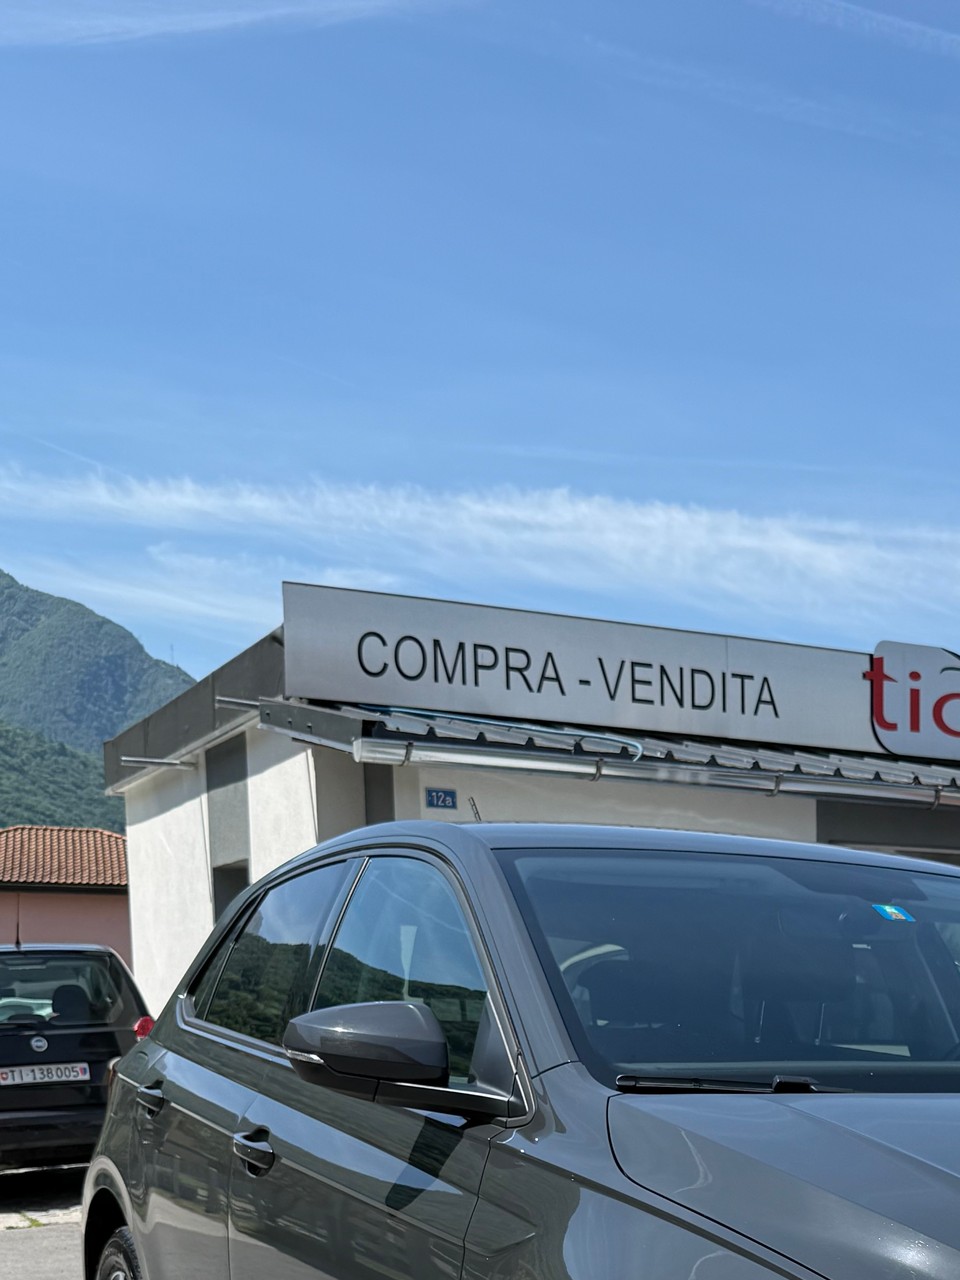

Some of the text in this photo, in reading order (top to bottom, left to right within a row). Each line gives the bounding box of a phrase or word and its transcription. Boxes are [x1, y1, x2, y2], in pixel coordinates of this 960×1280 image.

[357, 631, 566, 696] COMPRA
[598, 657, 780, 718] VENDITA
[431, 792, 453, 806] 12a
